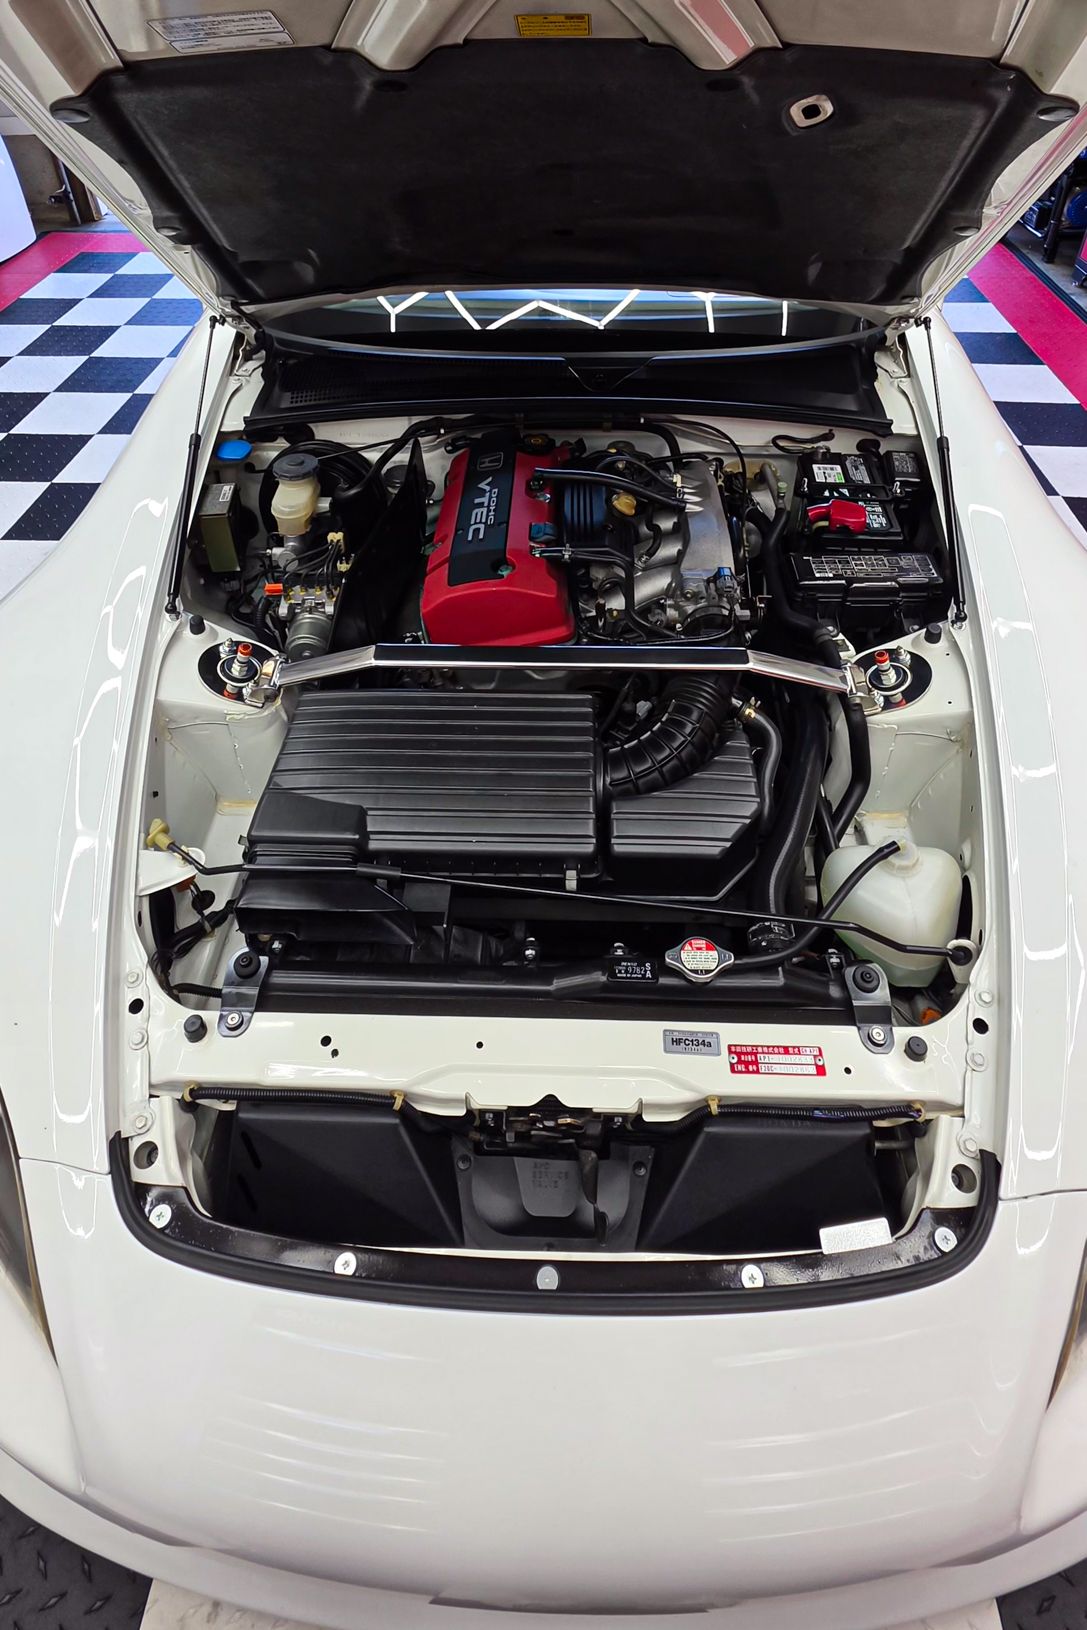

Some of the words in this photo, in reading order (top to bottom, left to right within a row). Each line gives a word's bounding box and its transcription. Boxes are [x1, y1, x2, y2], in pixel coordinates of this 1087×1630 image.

[467, 476, 493, 541] VTEC
[487, 488, 498, 525] DOHC
[671, 1037, 712, 1048] HFC134a
